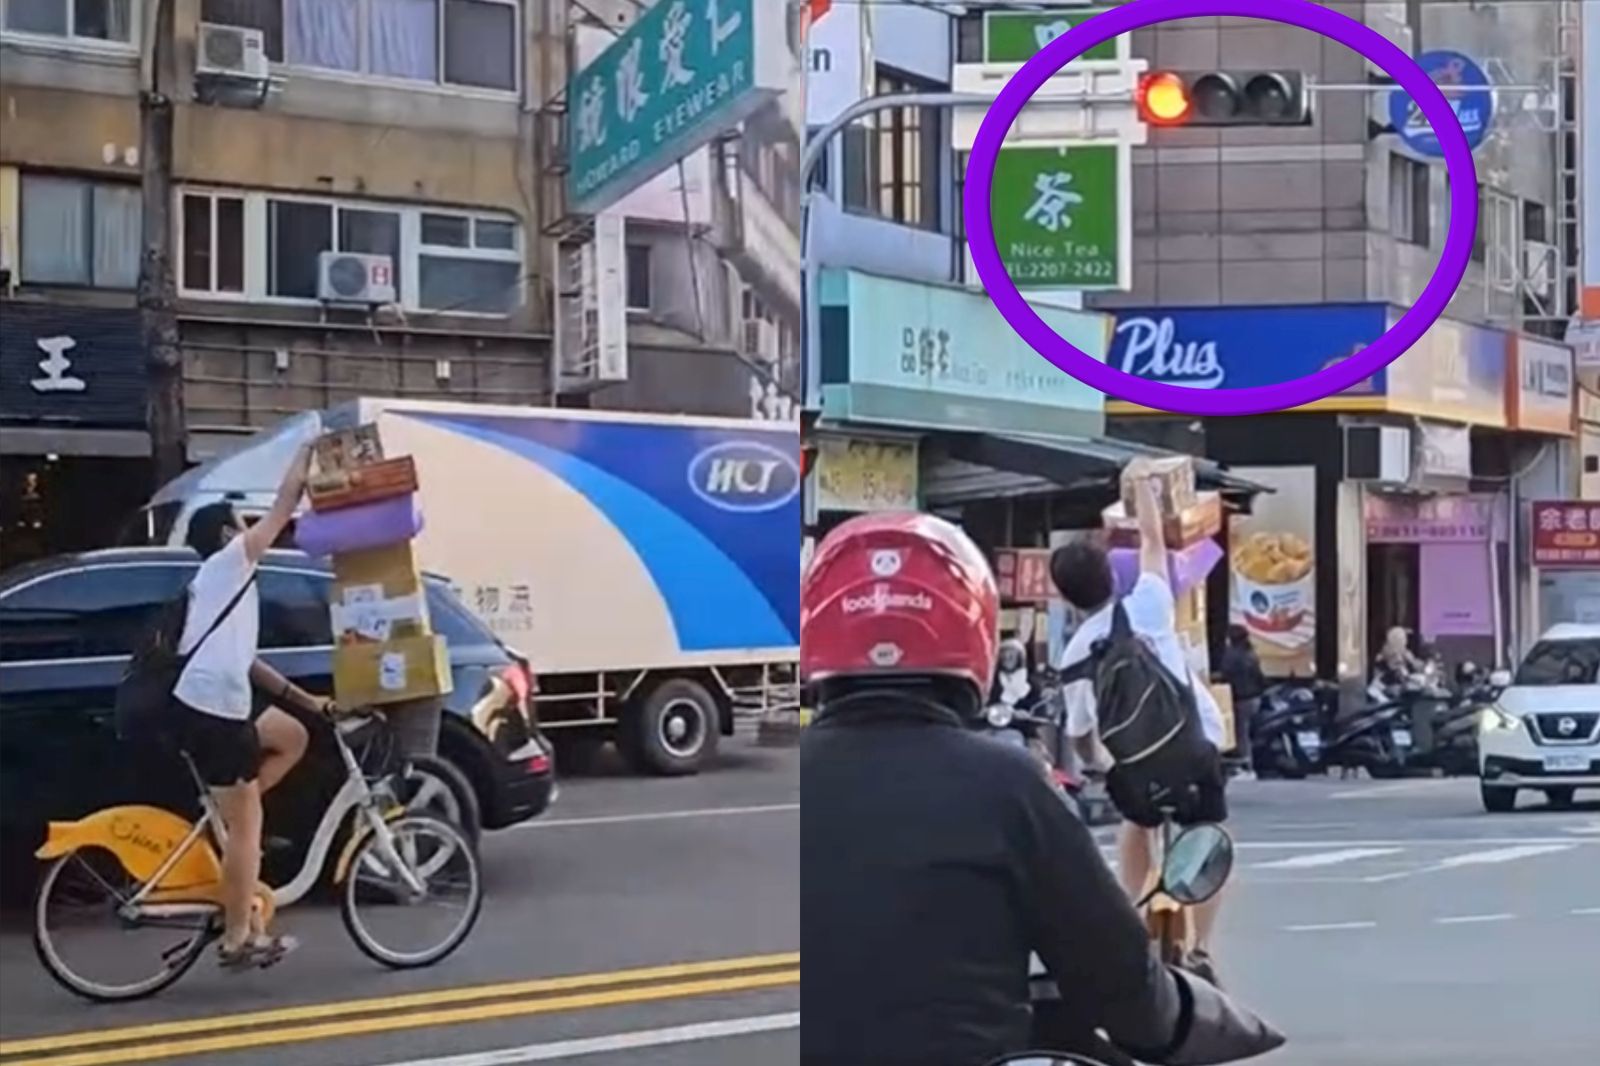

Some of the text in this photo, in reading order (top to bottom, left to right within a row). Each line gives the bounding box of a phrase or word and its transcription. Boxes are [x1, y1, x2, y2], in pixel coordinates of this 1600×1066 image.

[653, 60, 745, 142] EYEWEAR
[1024, 171, 1083, 232] 茶
[1010, 241, 1099, 258] Nice Tea
[31, 335, 86, 391] 王
[1116, 317, 1225, 388] Plus
[707, 459, 780, 494] HCT
